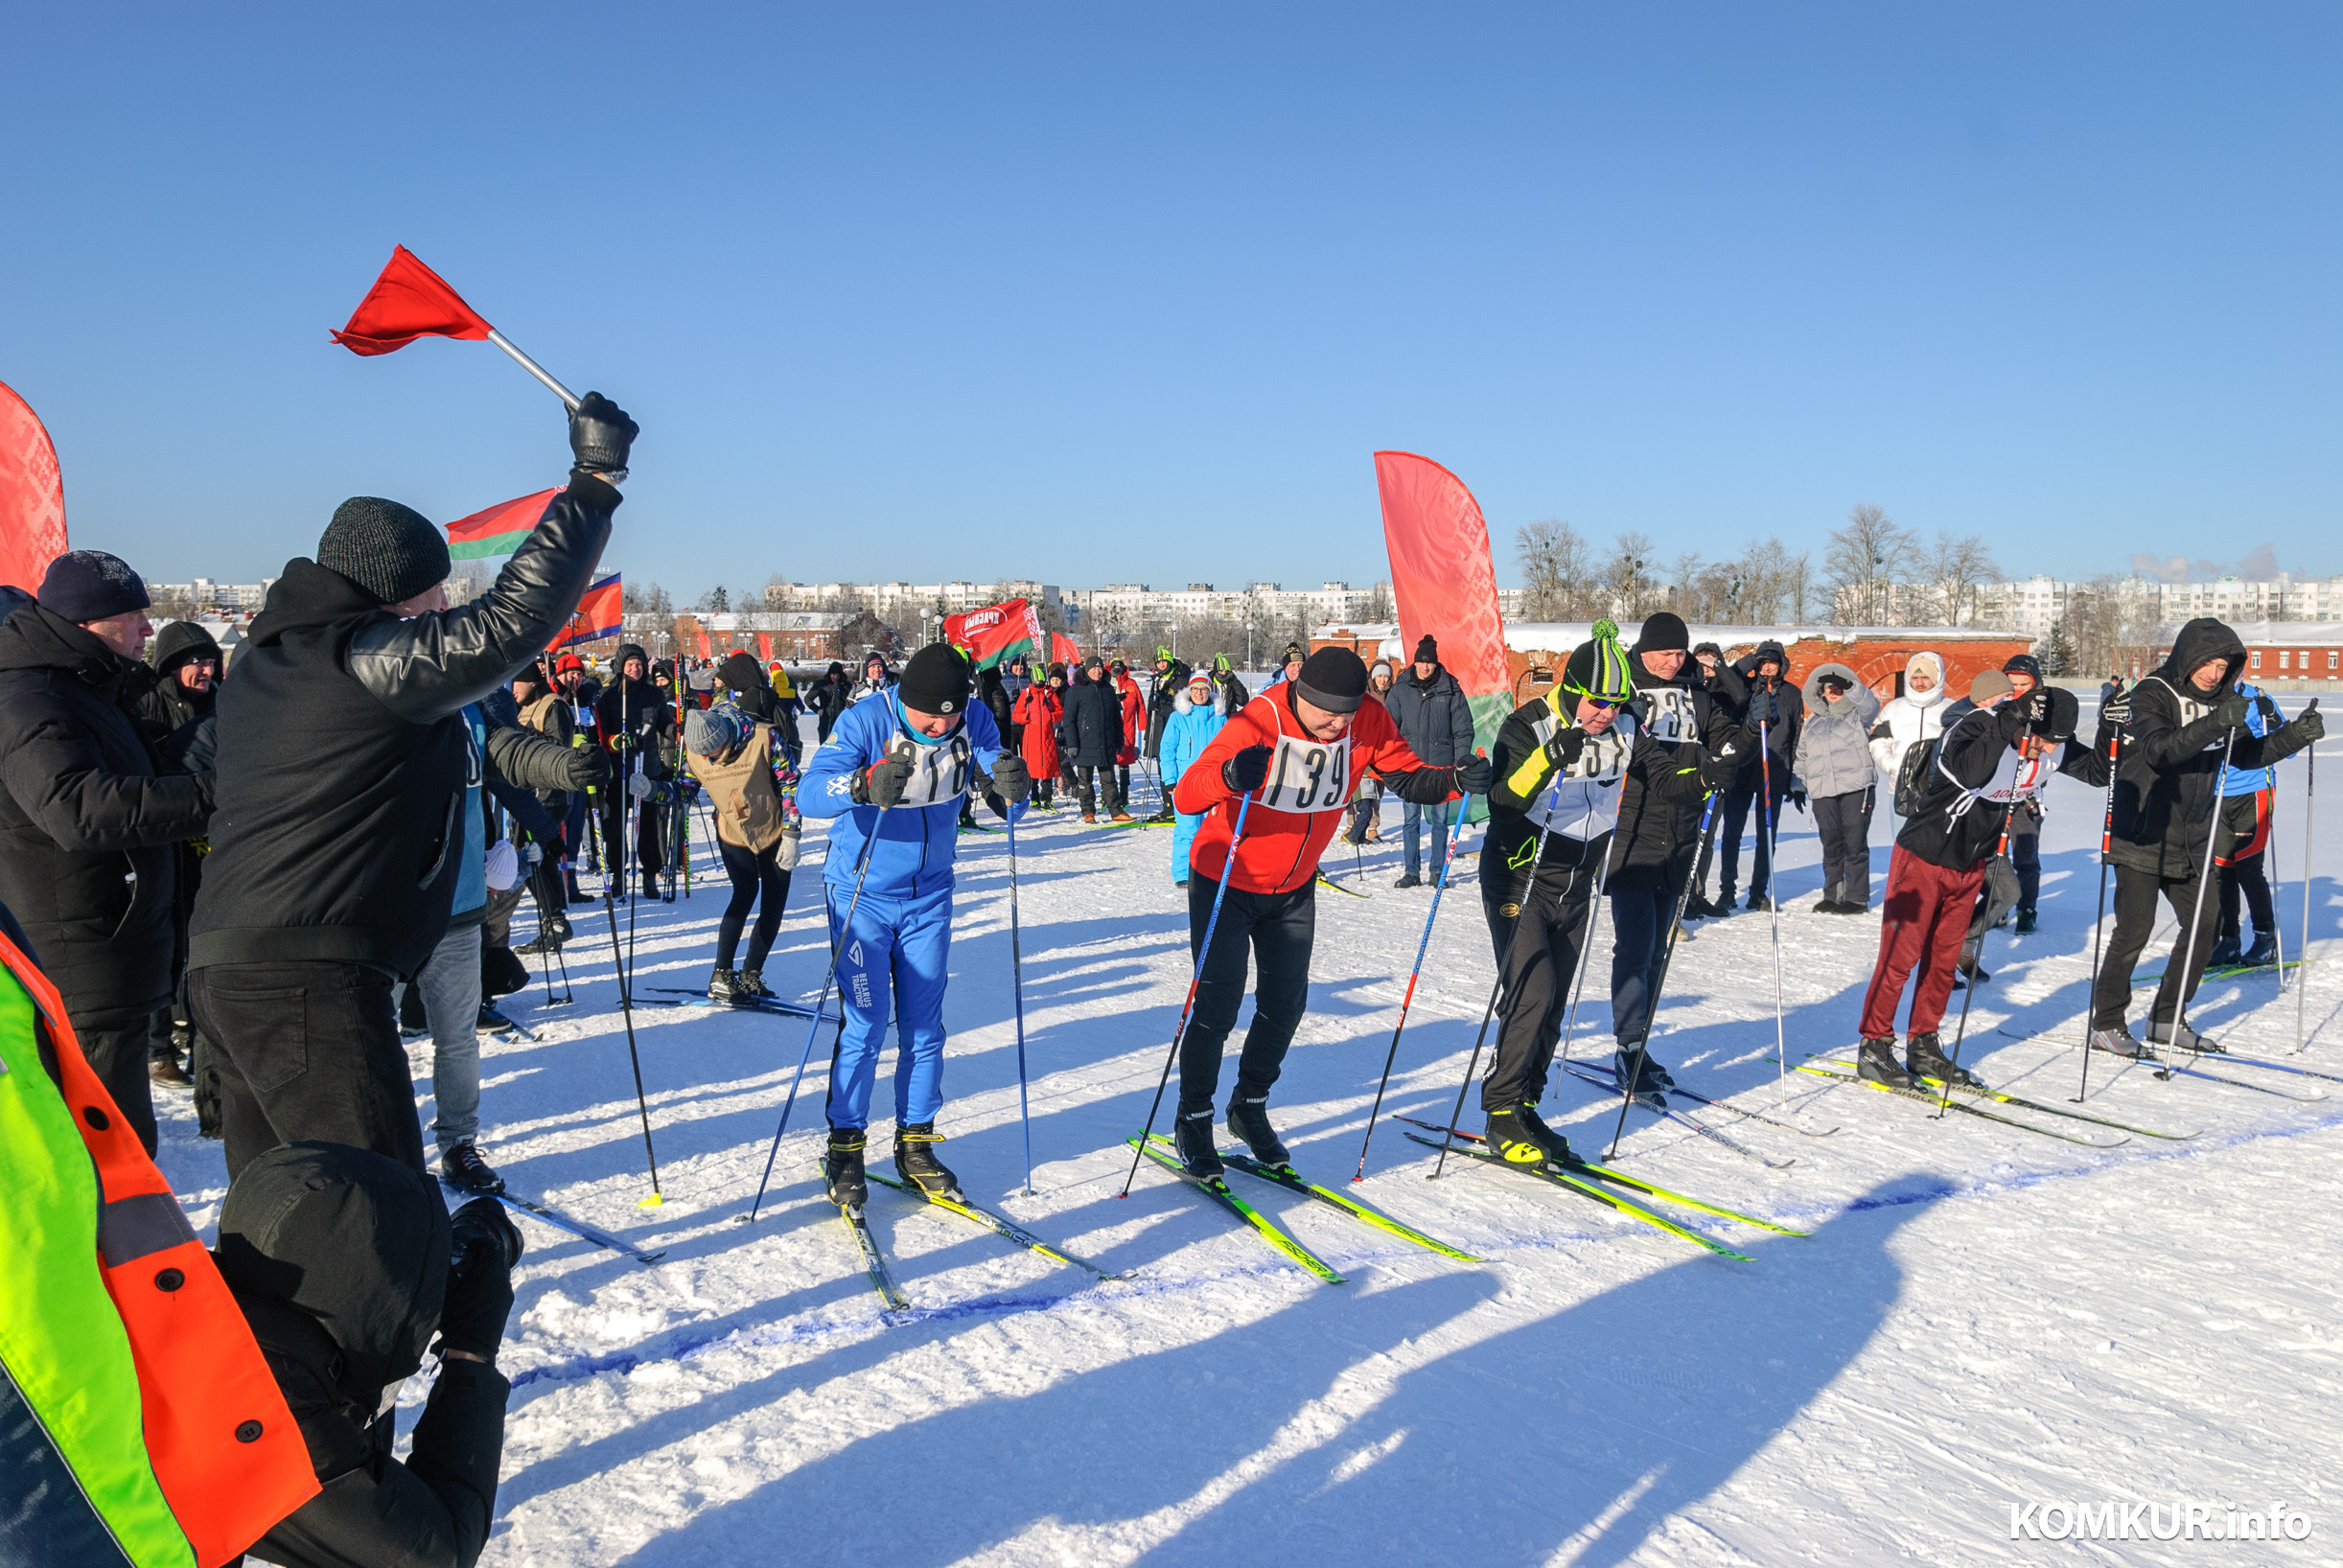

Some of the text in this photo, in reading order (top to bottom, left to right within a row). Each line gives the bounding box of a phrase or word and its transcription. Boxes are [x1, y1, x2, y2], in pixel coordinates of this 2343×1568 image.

[1267, 742, 1344, 809] 139
[852, 975, 865, 1008] TRACTORS
[859, 973, 872, 1008] BELARUS
[1258, 1168, 1280, 1180] FISCHER
[852, 1228, 881, 1272] FISCHER
[1278, 1240, 1327, 1272] FISCHER
